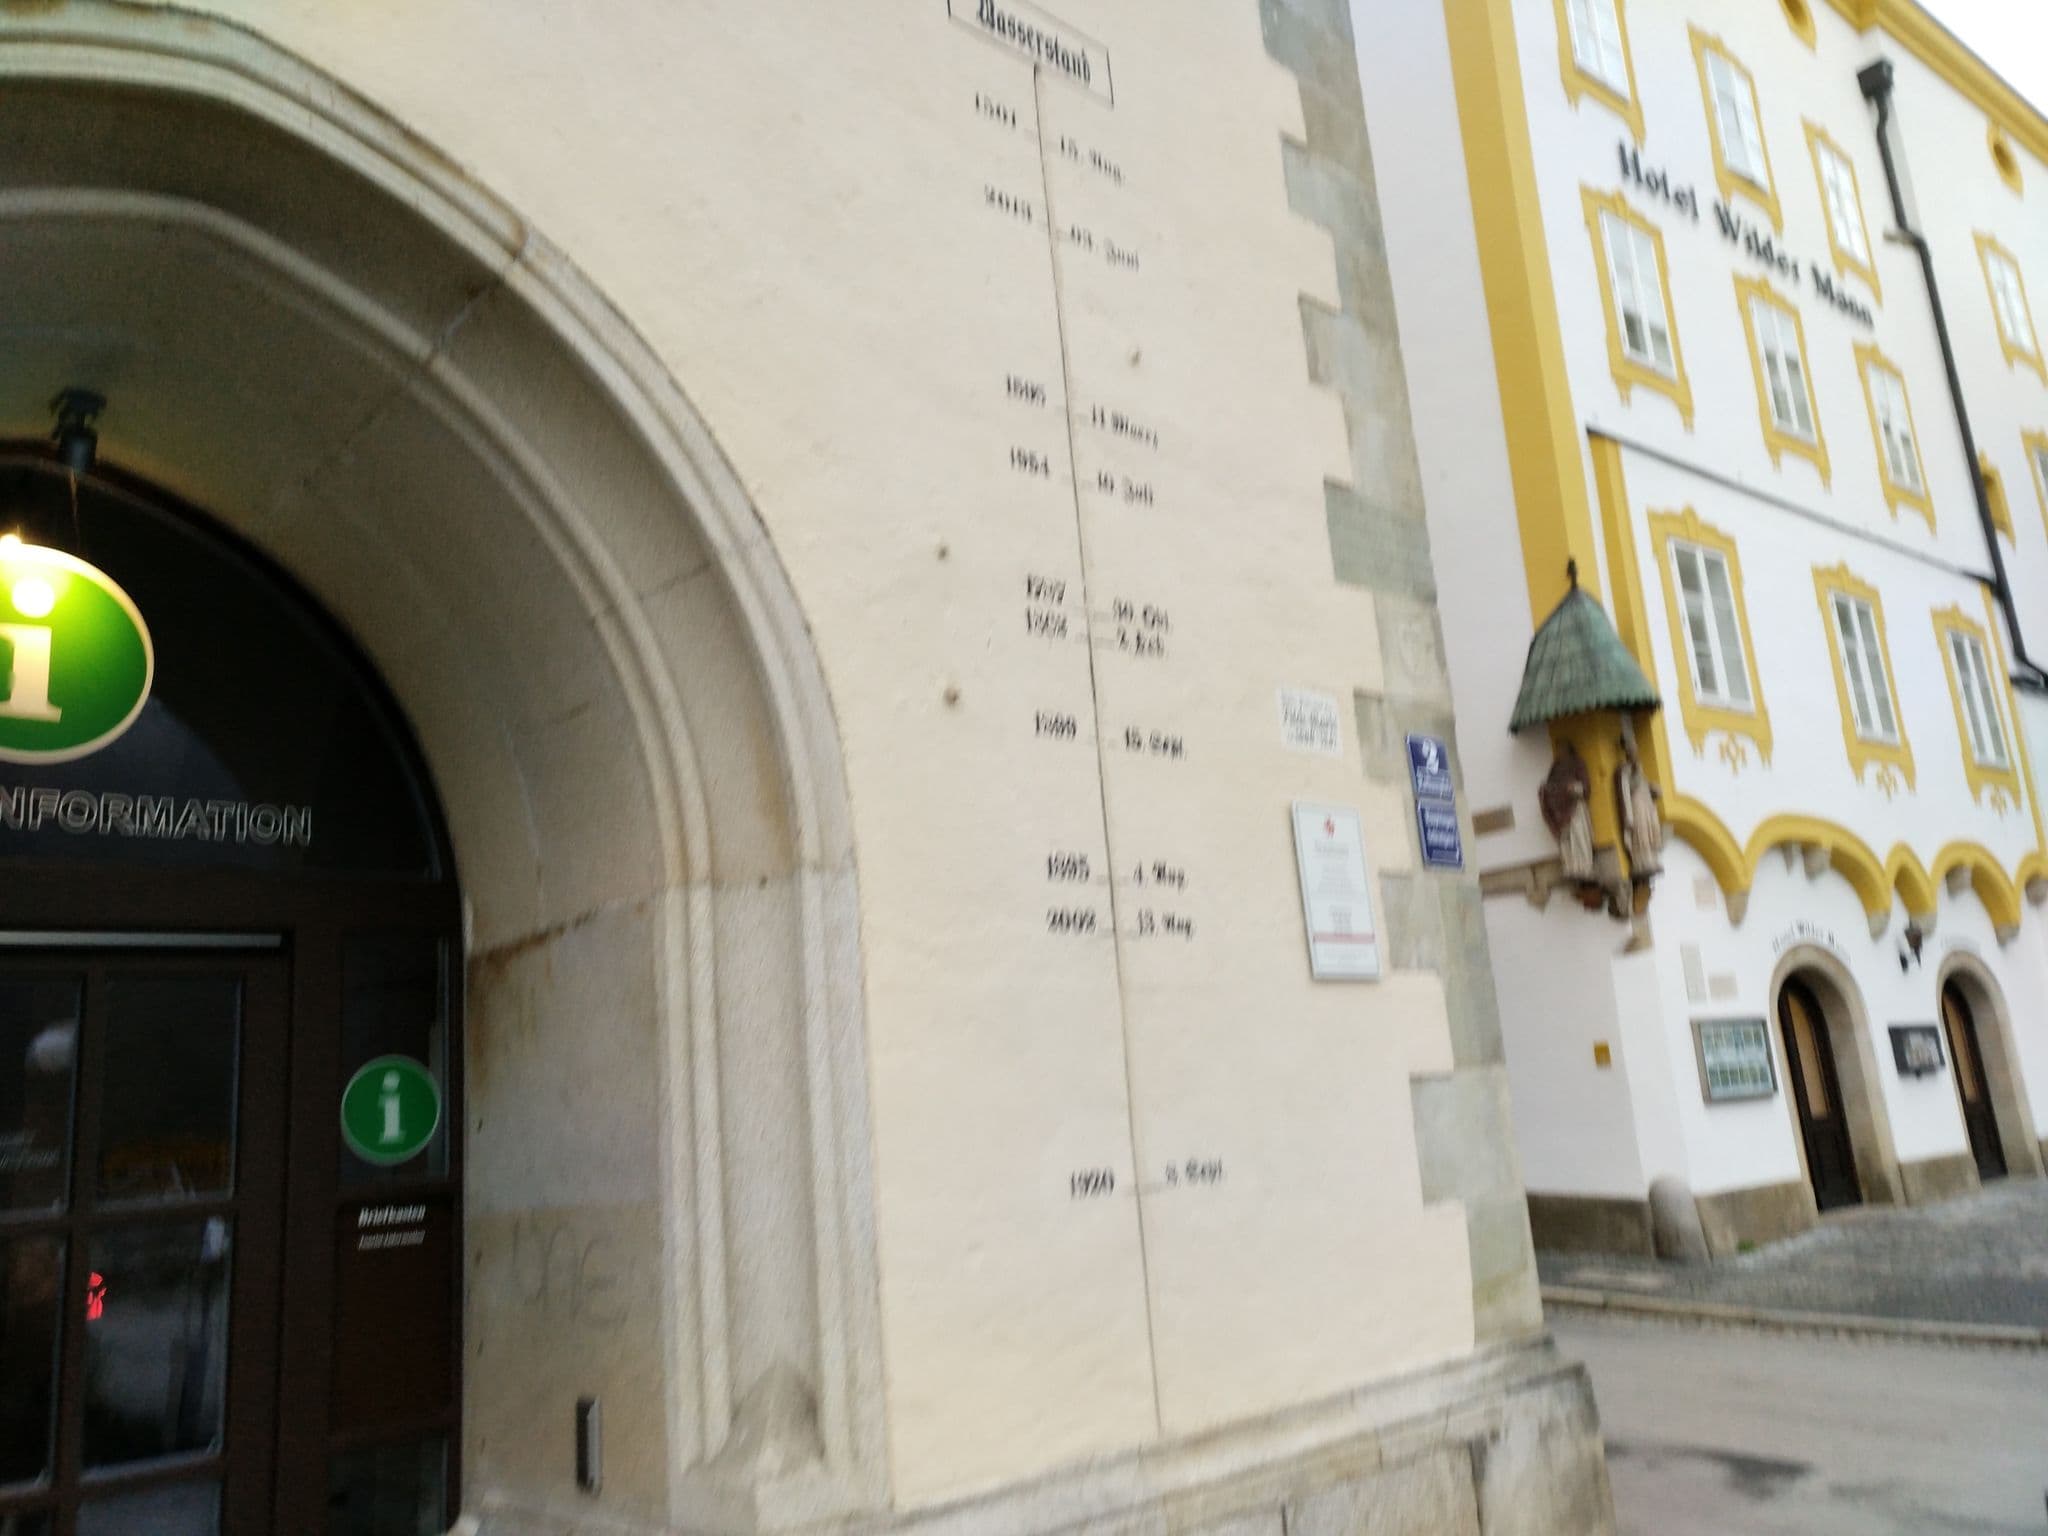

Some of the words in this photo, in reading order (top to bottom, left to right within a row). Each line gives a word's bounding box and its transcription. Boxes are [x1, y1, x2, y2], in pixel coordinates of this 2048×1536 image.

[1616, 139, 1700, 222] Hotel
[1713, 200, 1801, 283] Wilder
[1810, 263, 1876, 329] Mann
[1421, 737, 1441, 776] 2
